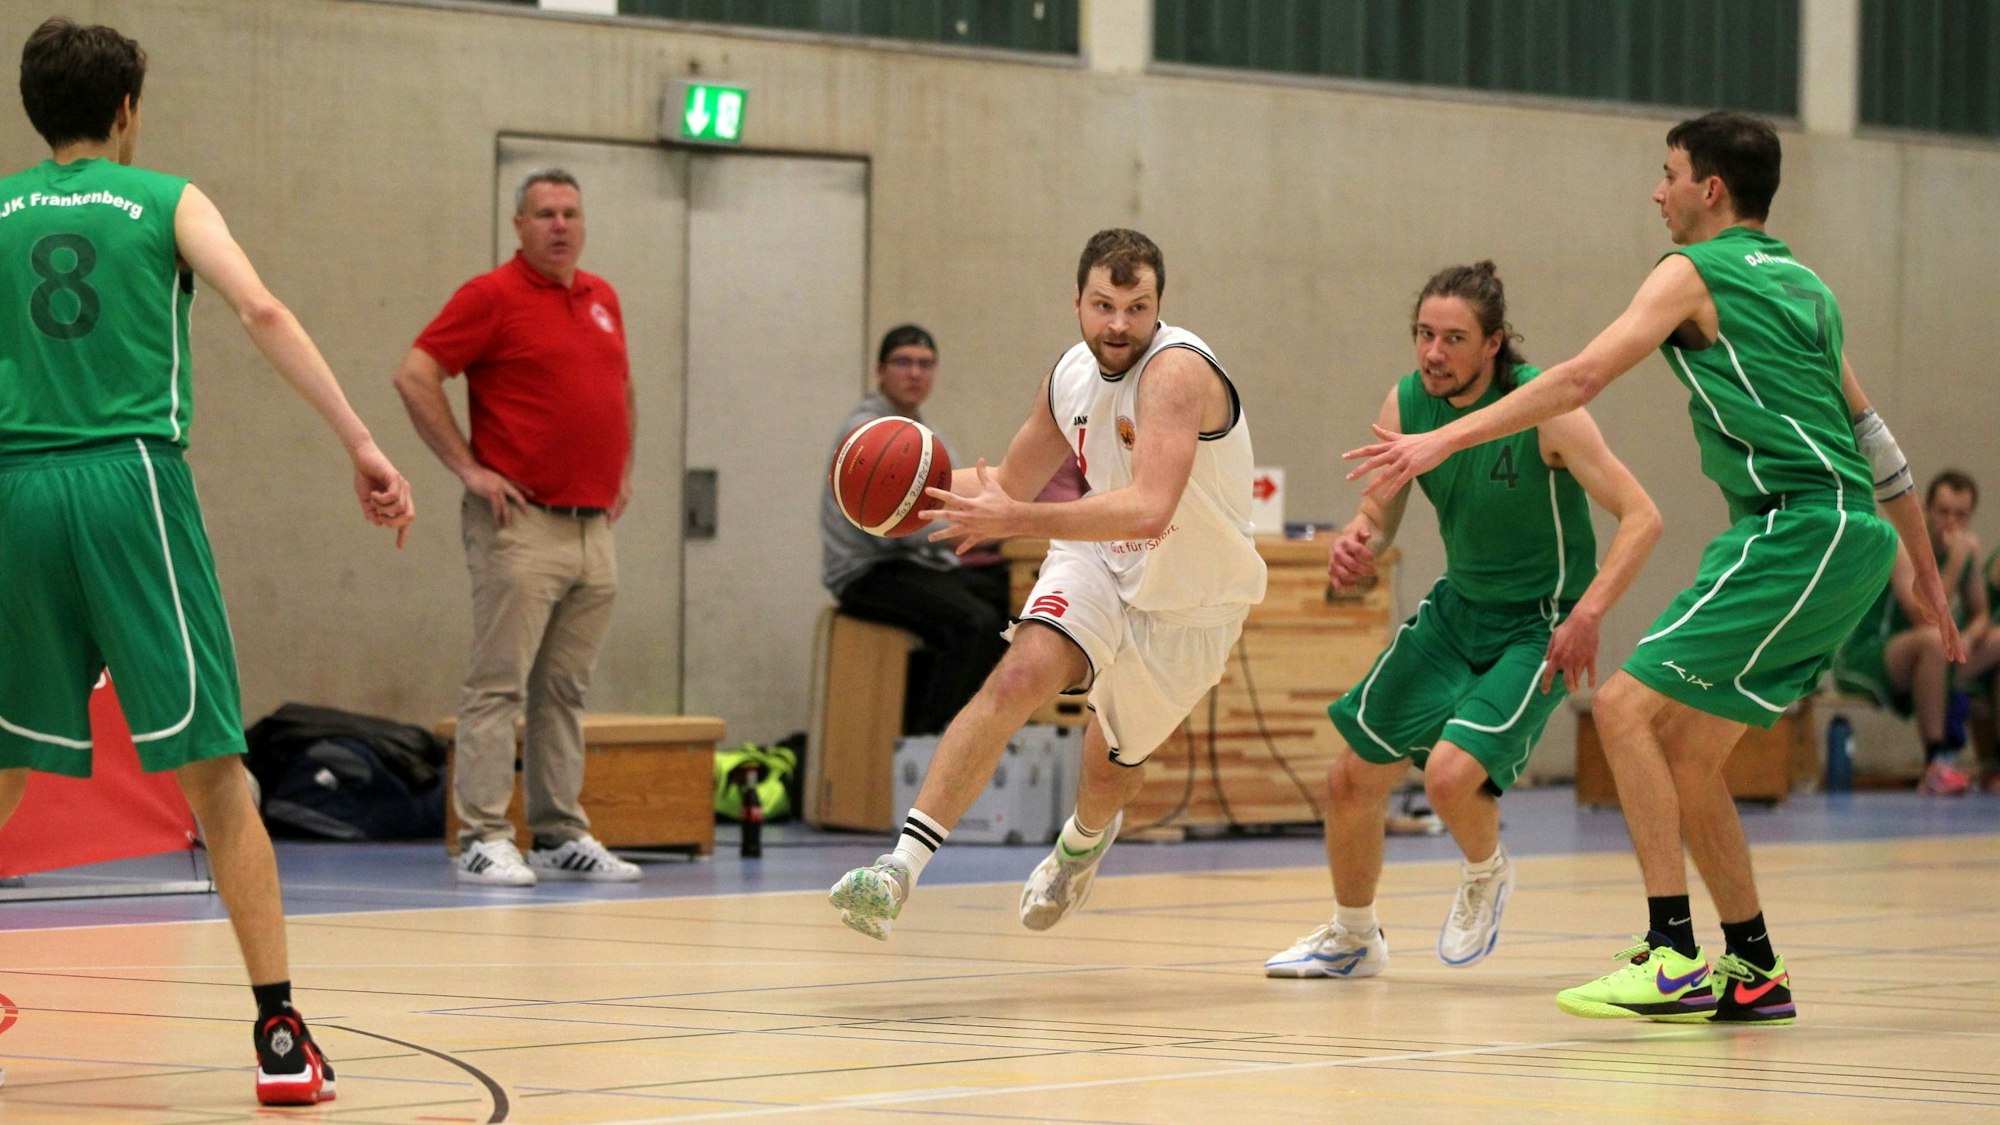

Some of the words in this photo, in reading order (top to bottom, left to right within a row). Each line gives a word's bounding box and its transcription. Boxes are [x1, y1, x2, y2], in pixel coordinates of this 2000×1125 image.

[0, 196, 26, 219] JK
[30, 191, 144, 219] Frankenberg
[29, 232, 101, 341] 8
[1781, 282, 1827, 346] 7
[1489, 444, 1521, 491] 4
[1125, 541, 1142, 553] für
